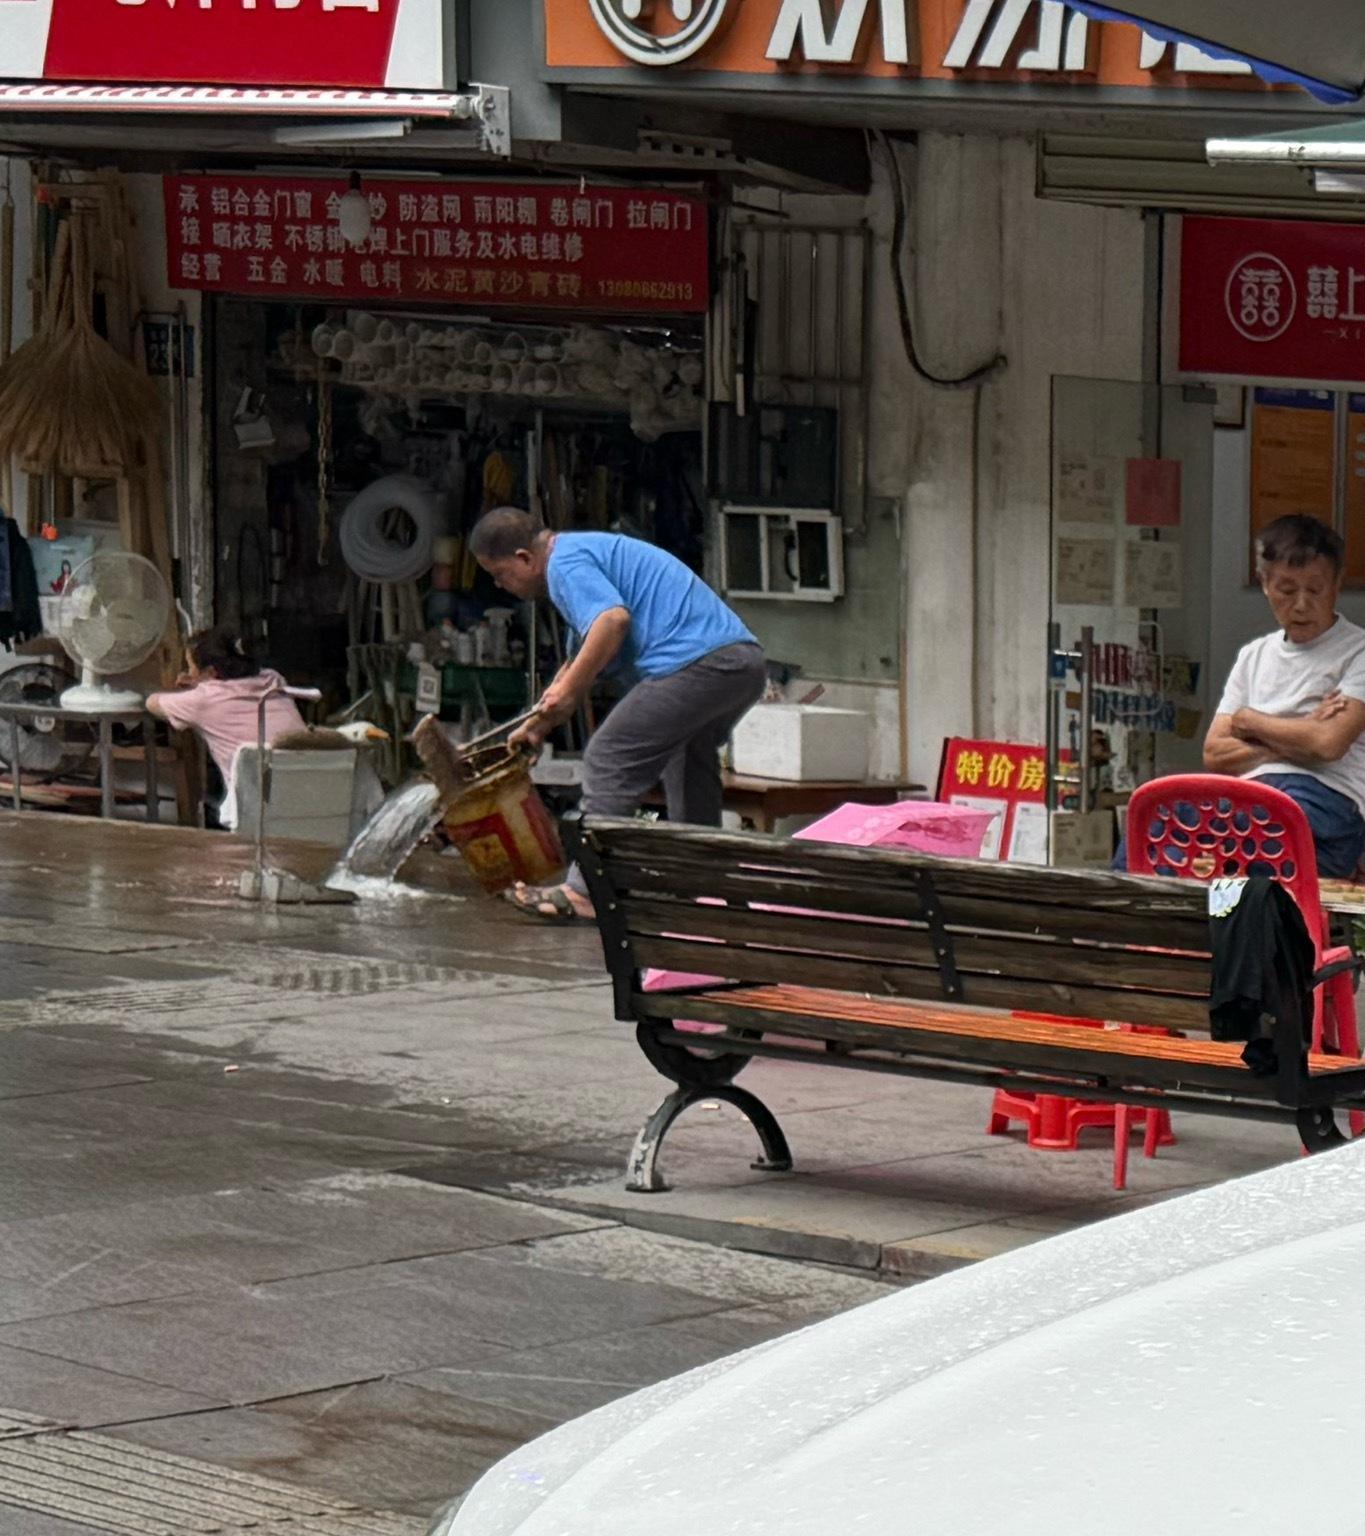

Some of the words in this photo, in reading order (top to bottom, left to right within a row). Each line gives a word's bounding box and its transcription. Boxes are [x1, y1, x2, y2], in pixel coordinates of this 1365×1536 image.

[212, 187, 312, 221] 铝合金门窗
[399, 192, 461, 224] 防盗网
[551, 198, 613, 228] 卷闸门
[627, 200, 692, 231] 拉闸门
[212, 222, 273, 250] 晒衣架
[181, 252, 221, 281] 经营
[247, 255, 288, 284] 五金
[303, 258, 344, 286] 水暖
[360, 260, 402, 290] 电料
